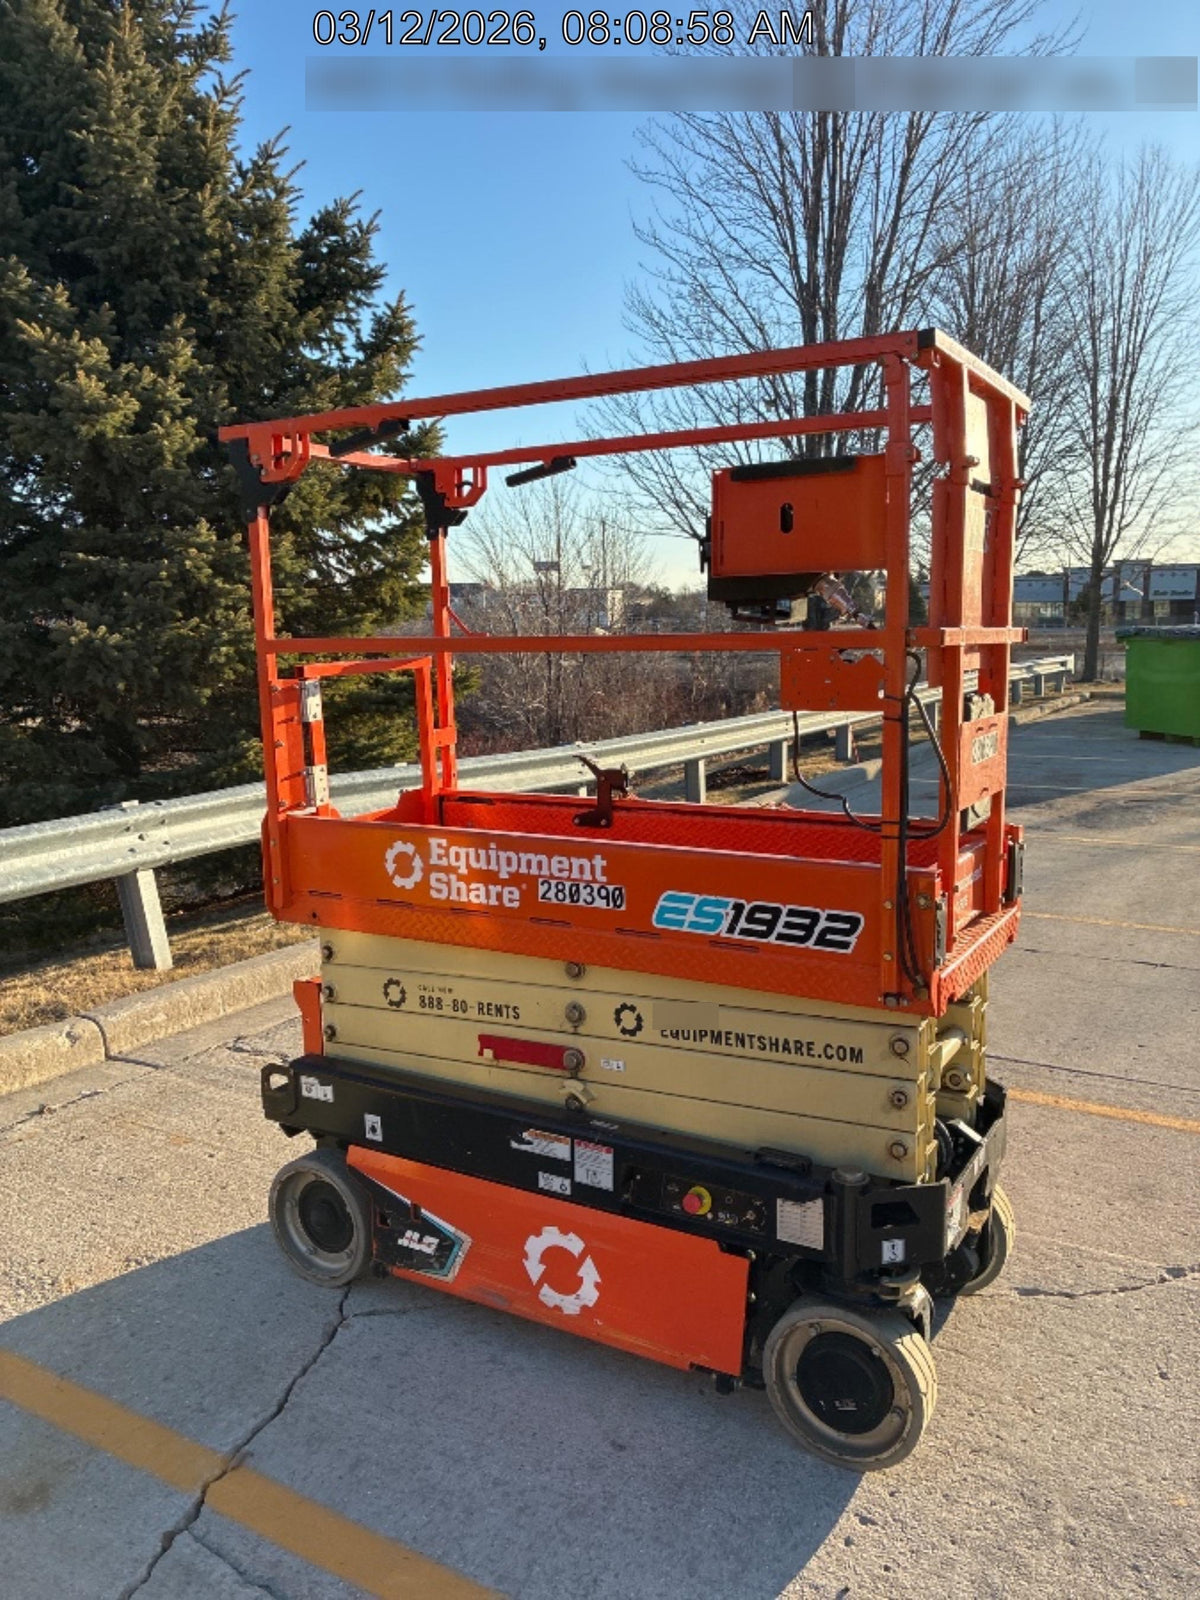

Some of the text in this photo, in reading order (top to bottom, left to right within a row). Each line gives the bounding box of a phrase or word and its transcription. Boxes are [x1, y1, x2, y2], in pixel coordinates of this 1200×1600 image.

[428, 837, 608, 882] Equipment
[429, 871, 520, 908] Share
[539, 879, 624, 910] 280390
[652, 890, 865, 953] ES1932
